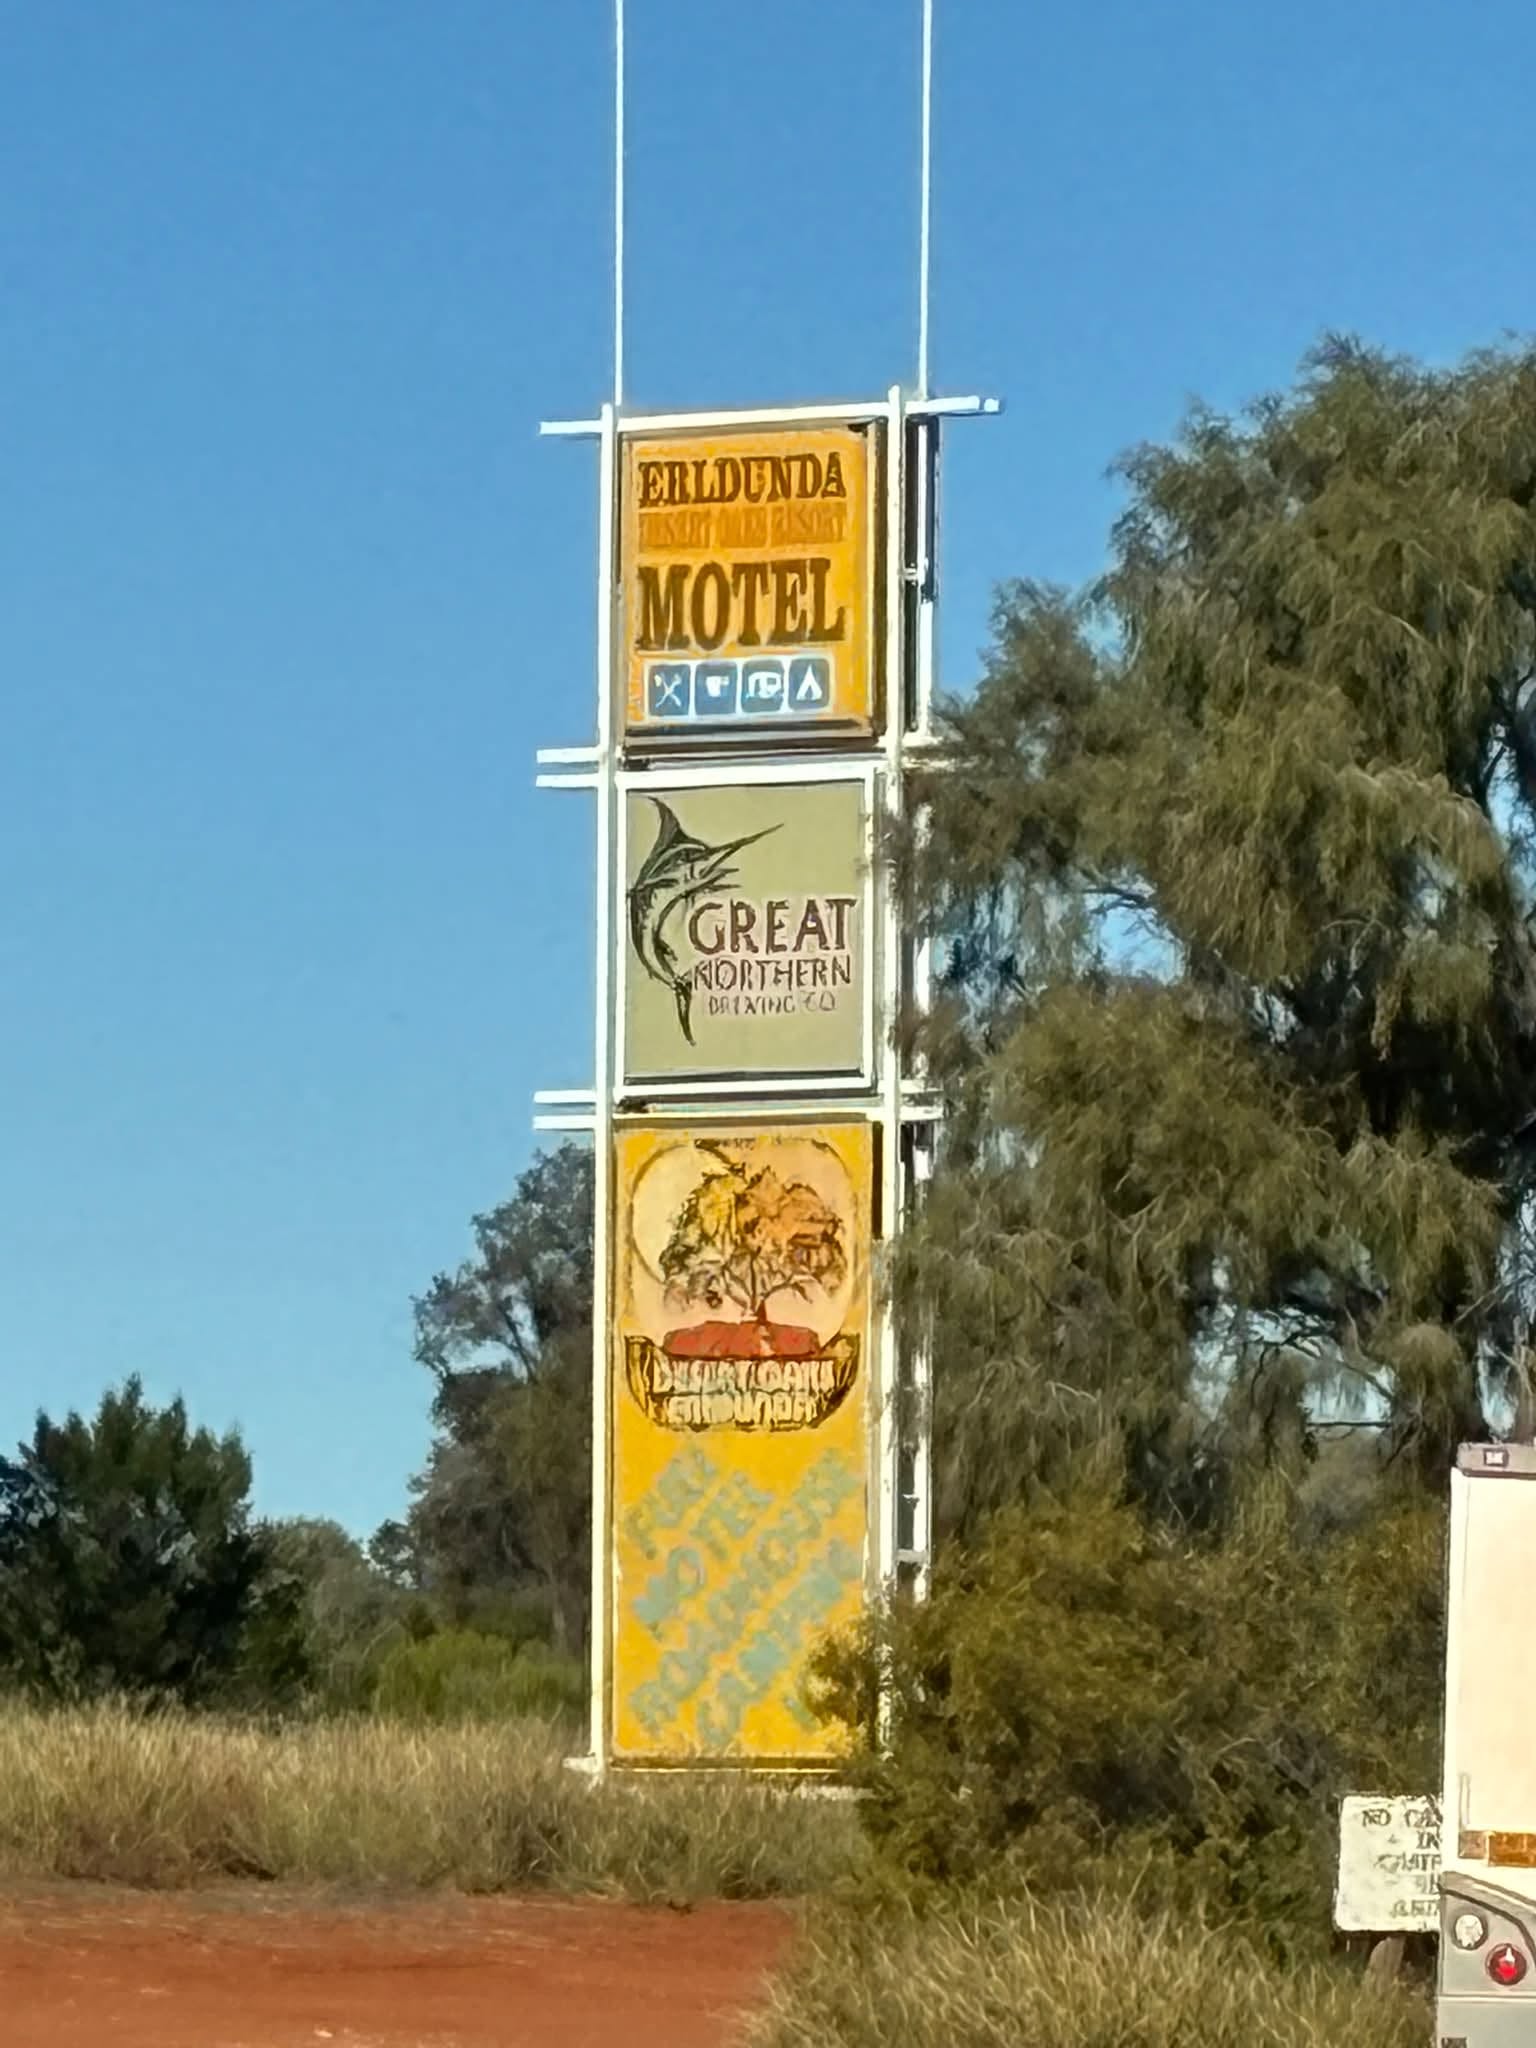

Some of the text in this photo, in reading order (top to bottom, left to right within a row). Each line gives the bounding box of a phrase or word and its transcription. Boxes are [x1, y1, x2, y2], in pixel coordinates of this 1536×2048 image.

[638, 452, 847, 508] ERLDUNDA
[635, 558, 846, 650] MOTEL
[688, 898, 857, 955] GREAT
[693, 955, 851, 991] NORTHERN
